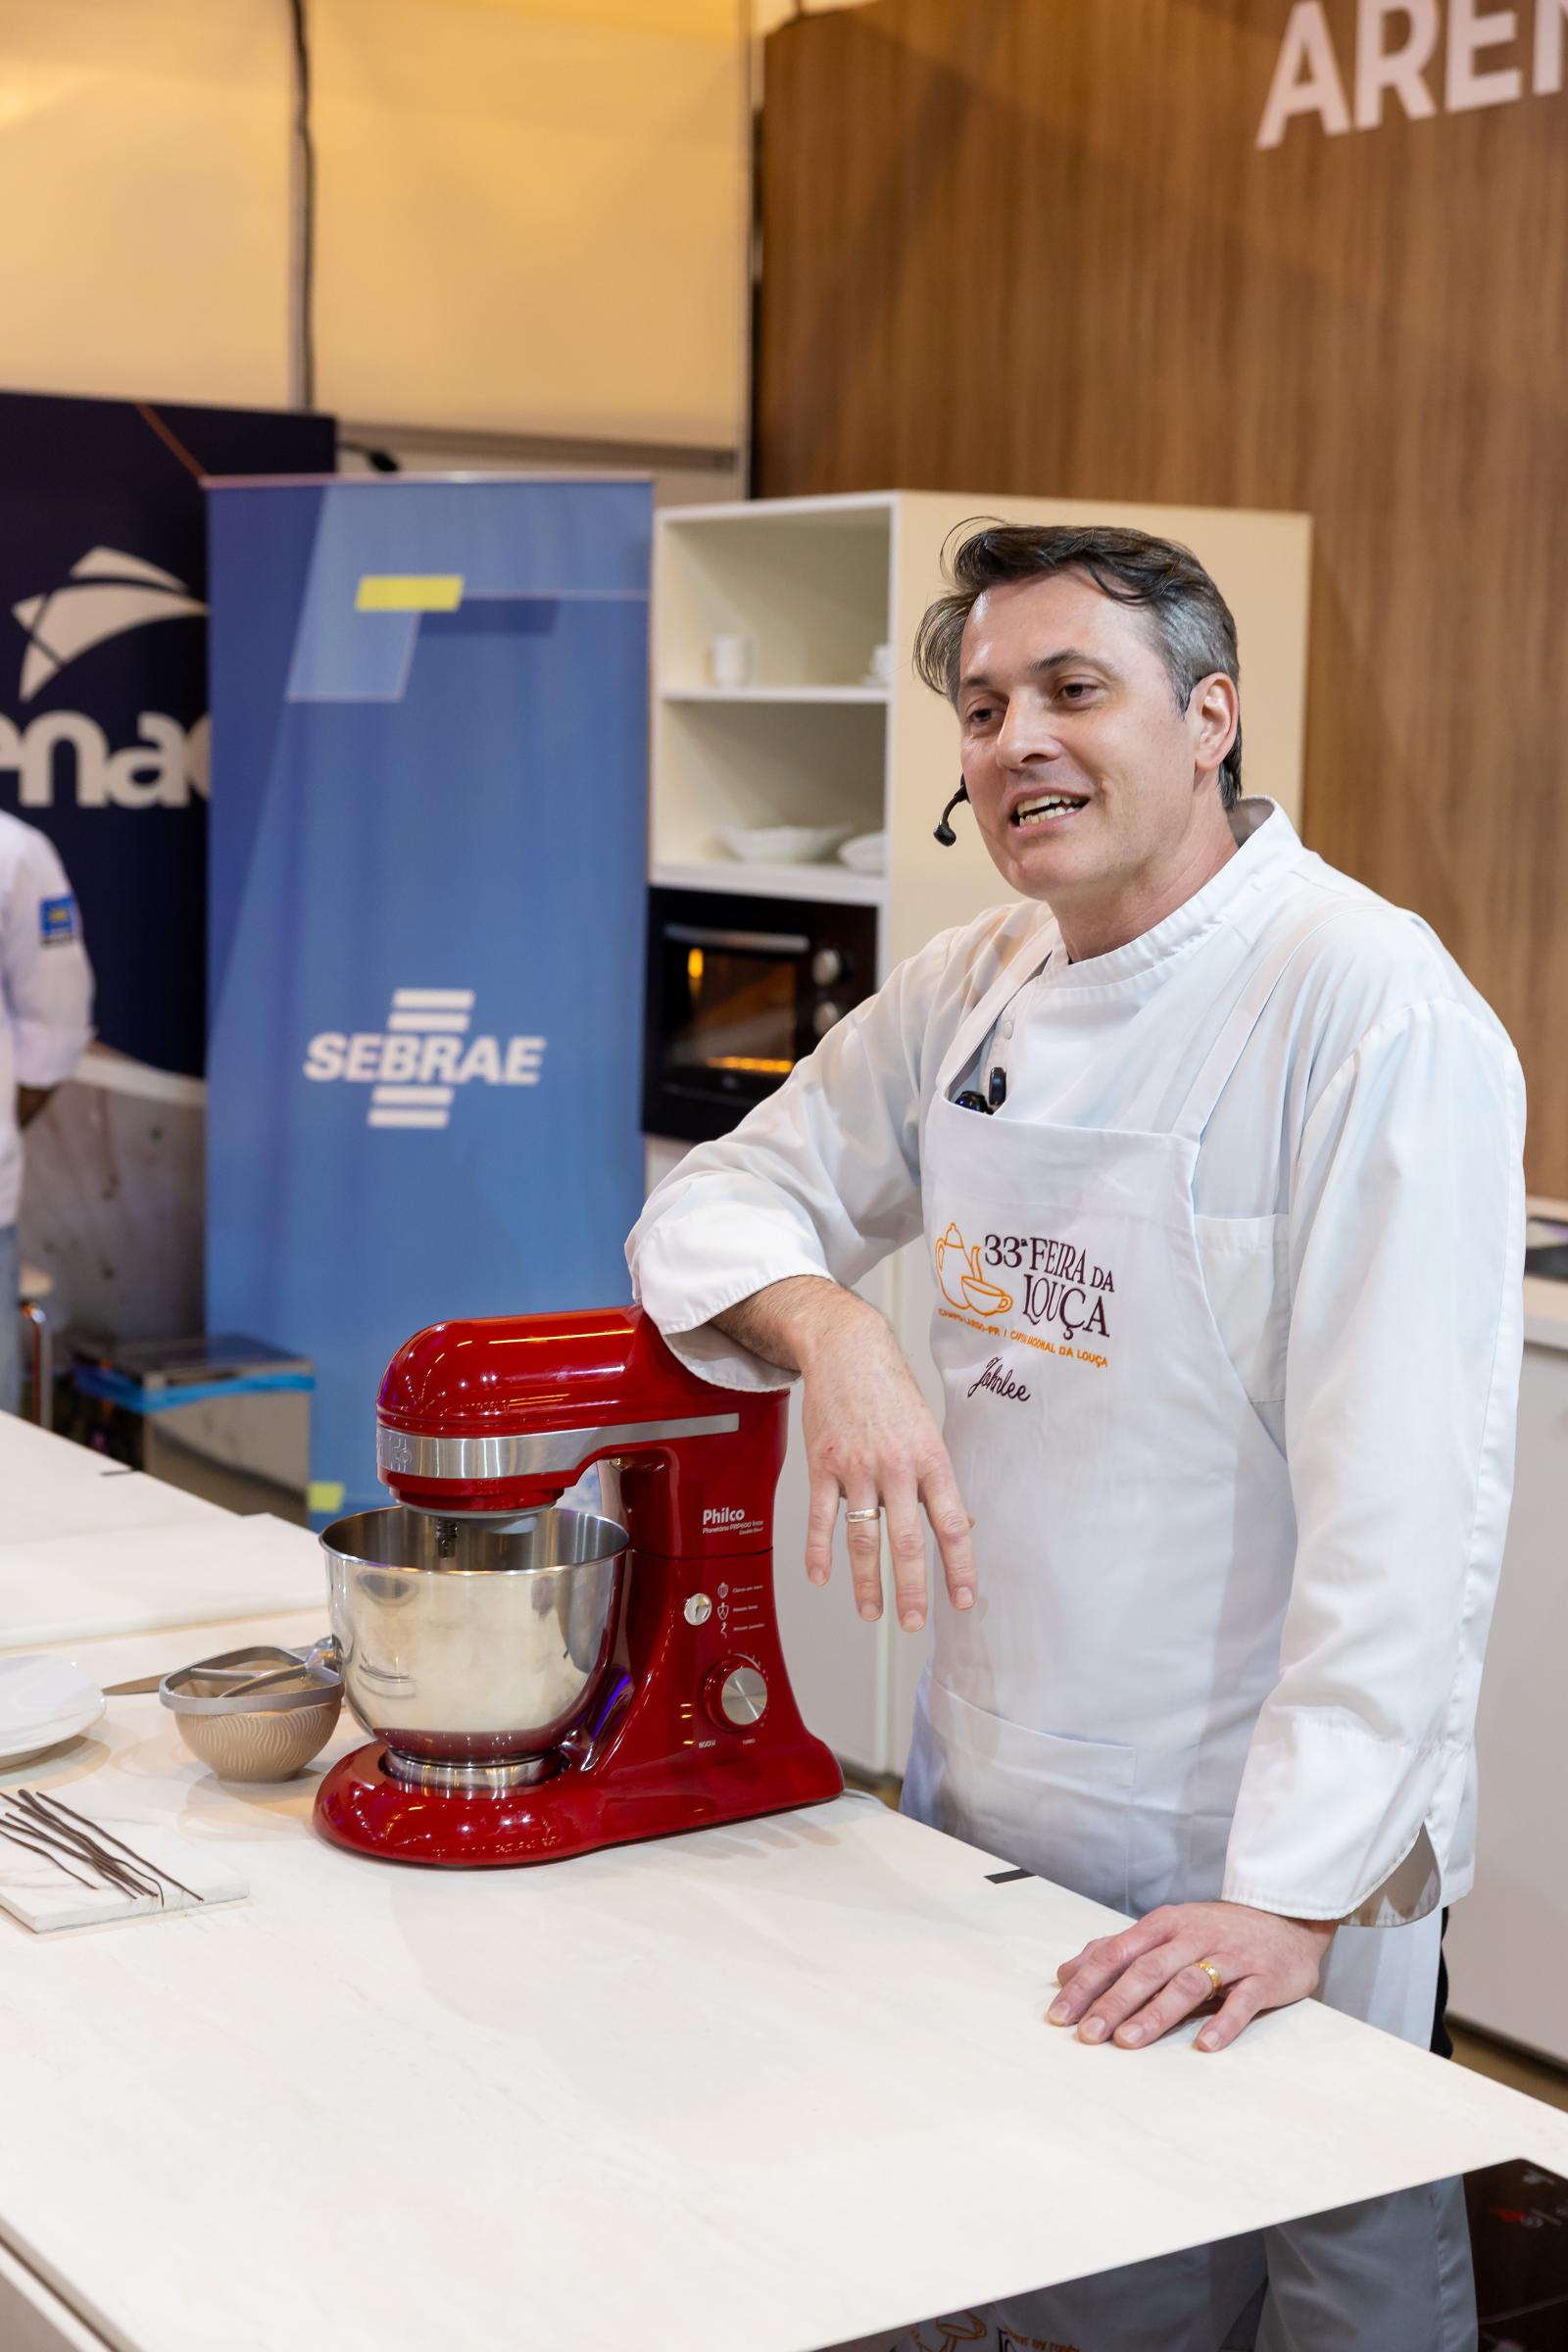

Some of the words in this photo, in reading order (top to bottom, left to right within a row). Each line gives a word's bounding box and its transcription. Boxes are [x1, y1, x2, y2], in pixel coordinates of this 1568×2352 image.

[302, 1032, 547, 1086] SEBRAE
[1028, 1237, 1086, 1285] FEIRA
[1089, 1266, 1115, 1293] DA
[1022, 1274, 1110, 1341] LOUÇA
[1058, 1346, 1074, 1358] DA
[1076, 1348, 1108, 1368] LOUÇA
[703, 1506, 746, 1525] Philco
